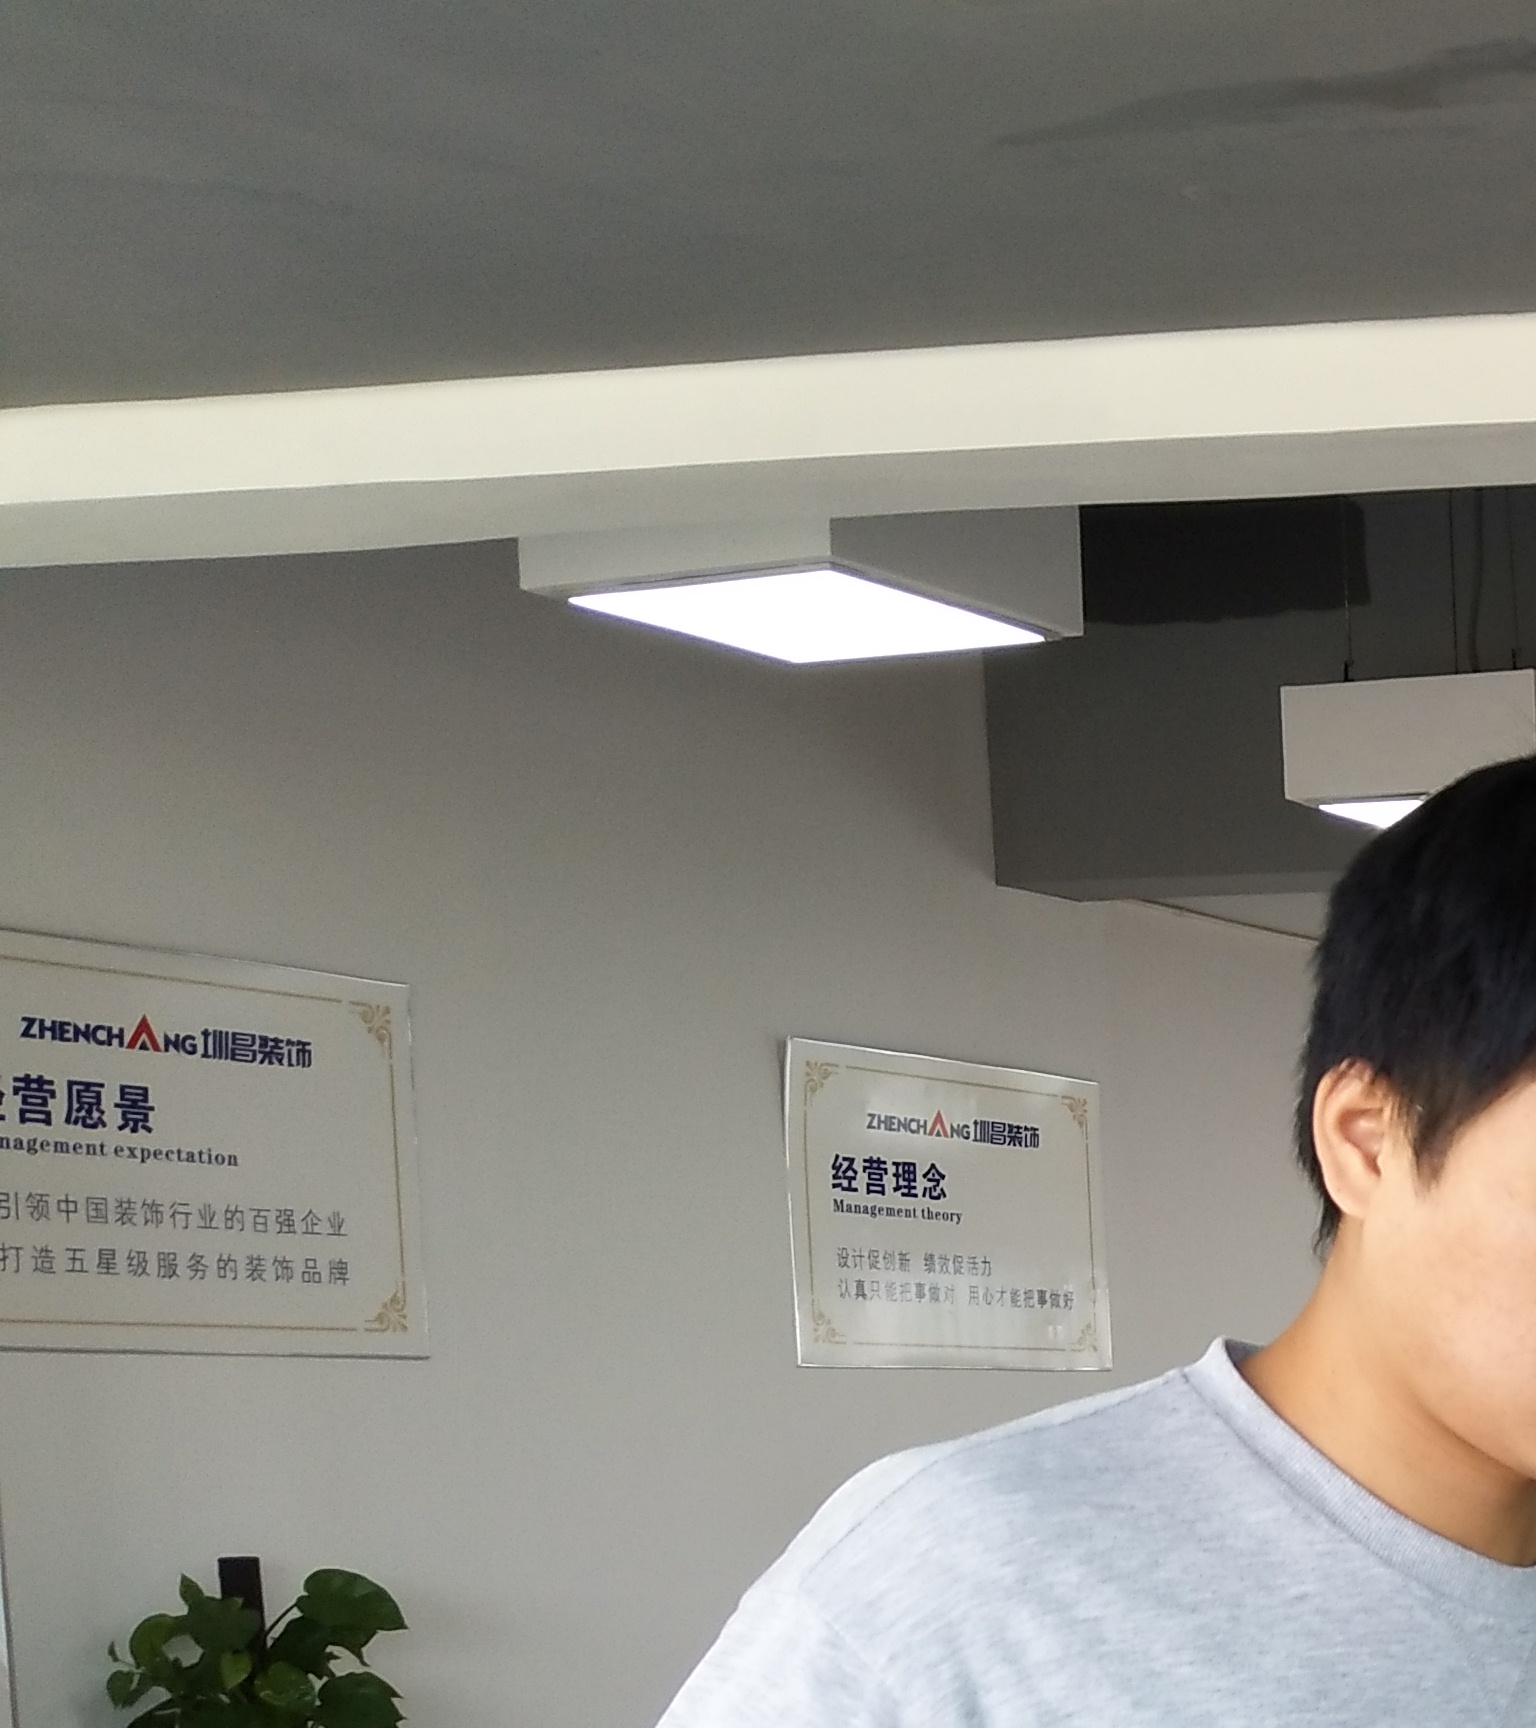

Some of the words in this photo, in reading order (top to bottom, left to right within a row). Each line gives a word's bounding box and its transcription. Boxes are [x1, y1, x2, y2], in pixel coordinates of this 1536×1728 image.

[20, 1013, 198, 1056] ZHENCHANG
[201, 1028, 313, 1069] 圳昌装饰
[0, 1073, 156, 1134] 营愿景
[866, 1109, 971, 1140] ZHENCHANG
[972, 1118, 1040, 1149] 圳昌装饰
[113, 1145, 239, 1167] expectation
[831, 1153, 947, 1201] 经营理念
[0, 1191, 348, 1238] 引领中国装饰行业的百强企业
[833, 1198, 918, 1219] Management
[921, 1206, 963, 1225] theory
[0, 1242, 350, 1287] 打造五星级服务的装饰品牌
[836, 1246, 911, 1273] 设计促创新
[923, 1251, 993, 1277] 绩效促活力
